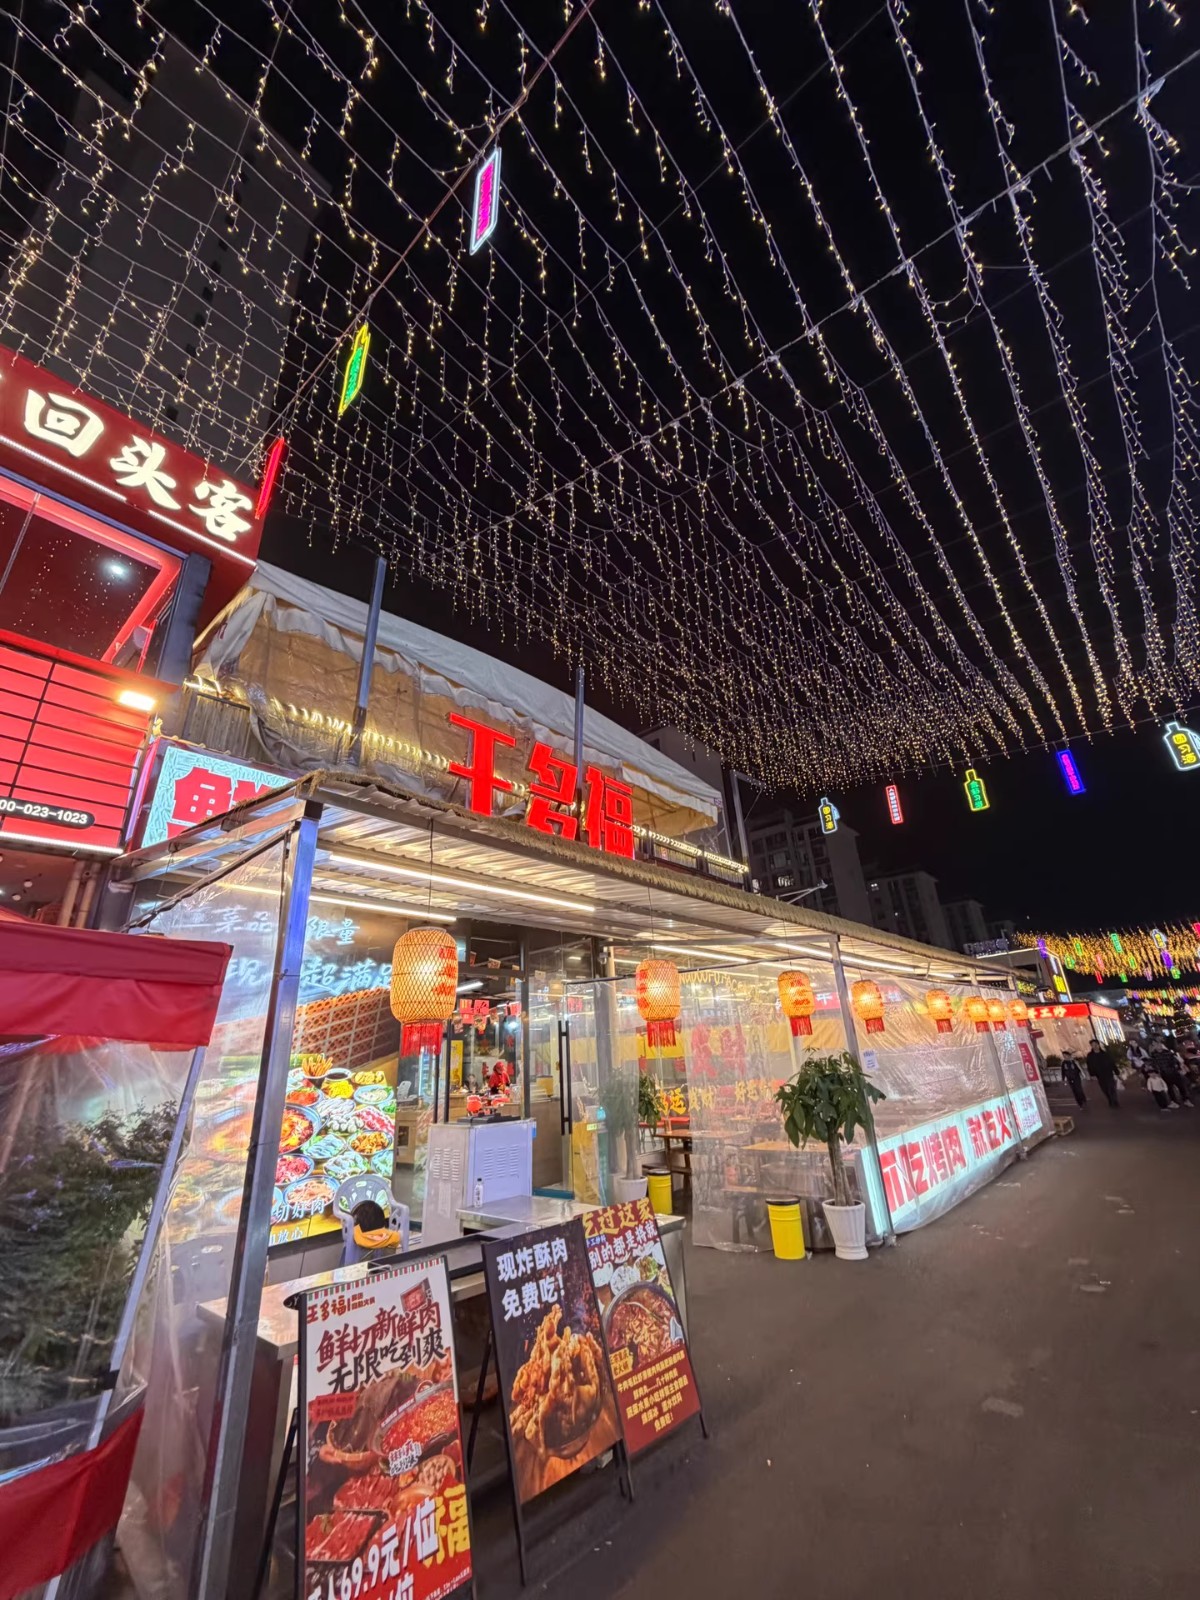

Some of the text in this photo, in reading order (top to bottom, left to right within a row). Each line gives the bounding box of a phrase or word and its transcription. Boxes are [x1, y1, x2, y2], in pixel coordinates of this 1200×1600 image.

[24, 389, 253, 542] 回头客
[965, 1097, 1023, 1159] 就吃火
[496, 1237, 568, 1283] 现炸酥肉
[588, 1220, 658, 1270] 别的都是将就
[307, 1294, 347, 1324] 王多福
[502, 1273, 565, 1322] 免费吃!
[316, 1299, 442, 1373] 鲜切新鲜肉
[328, 1327, 448, 1395] 无限吃到爽
